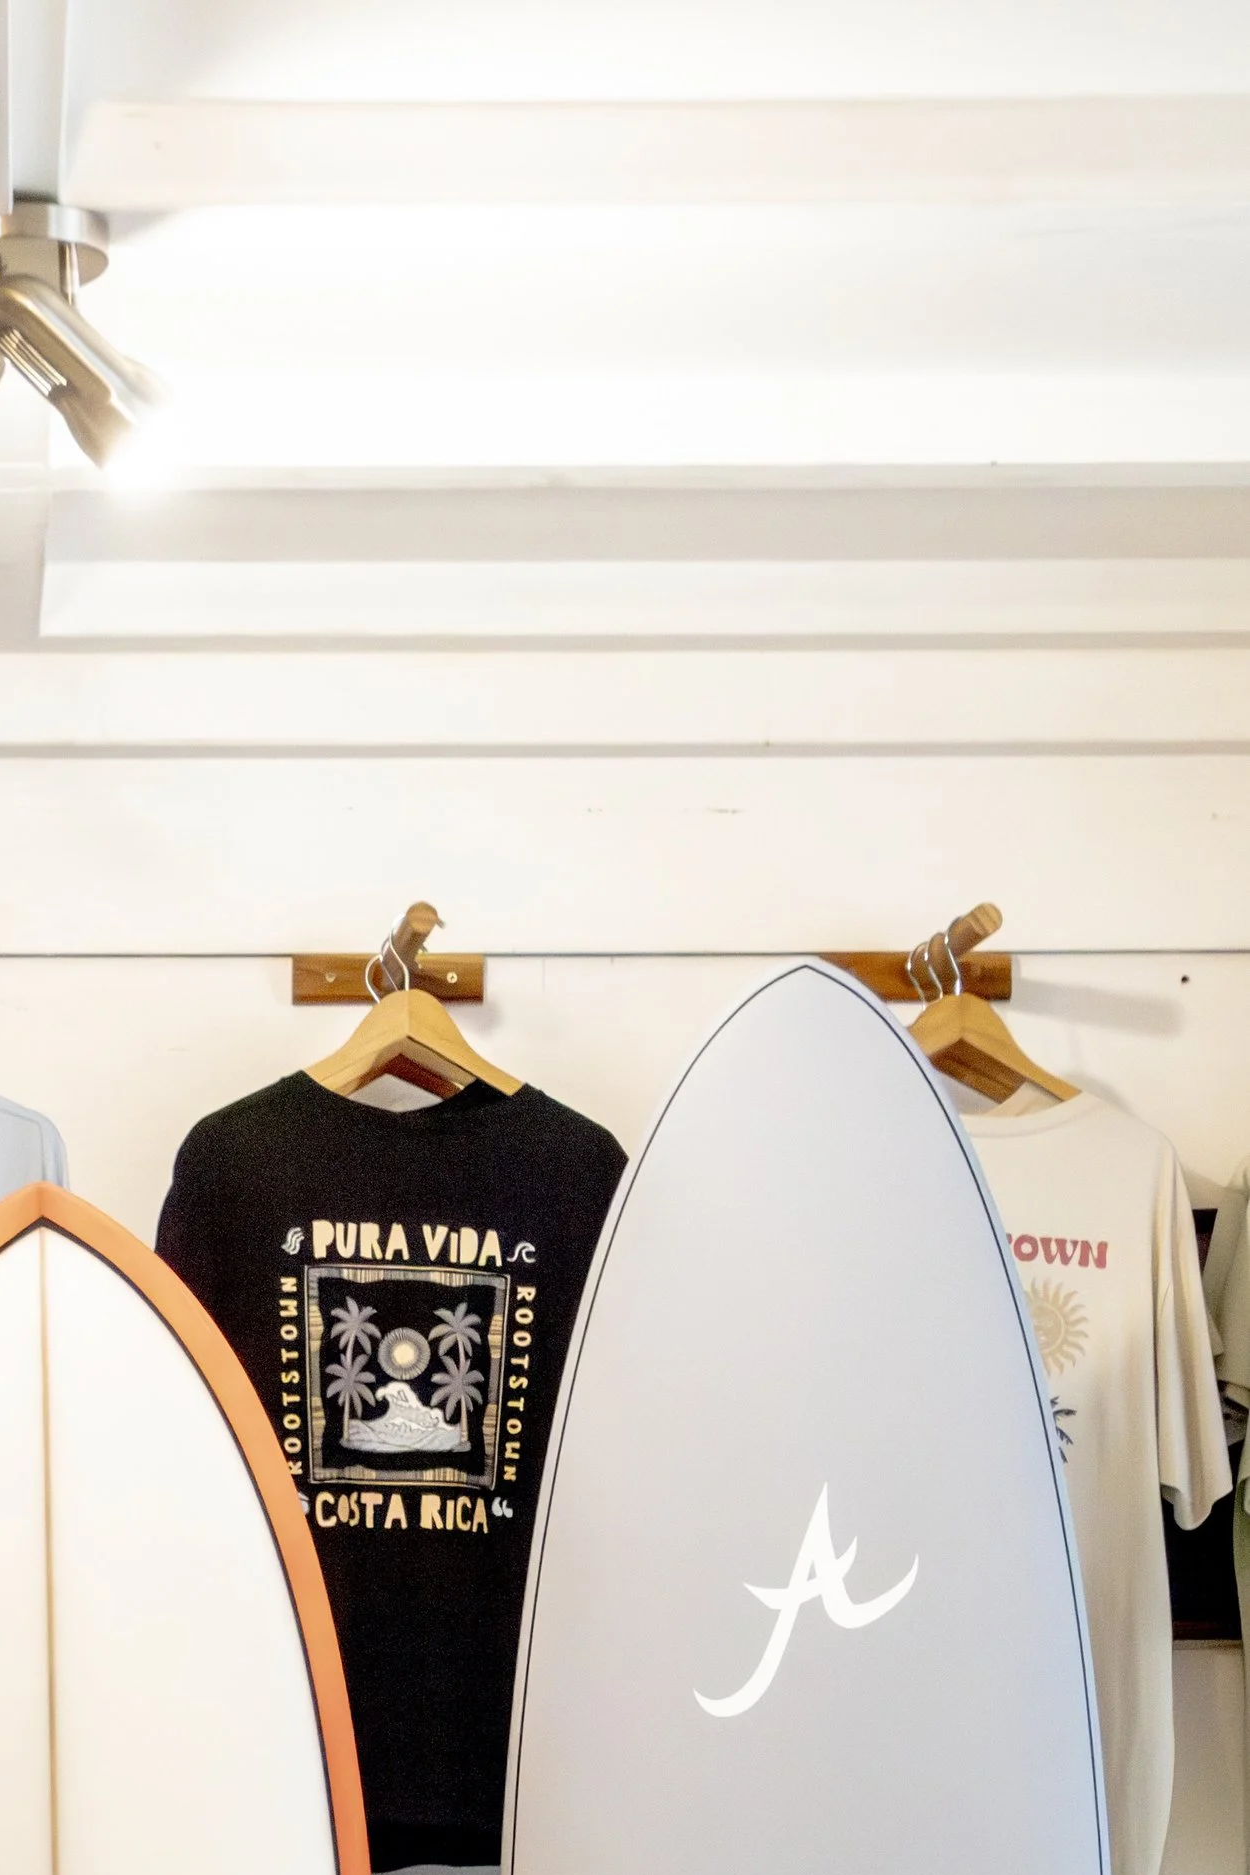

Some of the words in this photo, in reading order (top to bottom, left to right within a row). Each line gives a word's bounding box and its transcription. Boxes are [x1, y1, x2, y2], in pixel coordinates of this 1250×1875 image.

[312, 1219, 410, 1261] PURA
[422, 1223, 502, 1267] VIDA
[1006, 1233, 1108, 1269] OWN
[504, 1285, 536, 1482] ROOTSTOWN
[315, 1491, 408, 1530] COSTA
[419, 1493, 489, 1534] RICA
